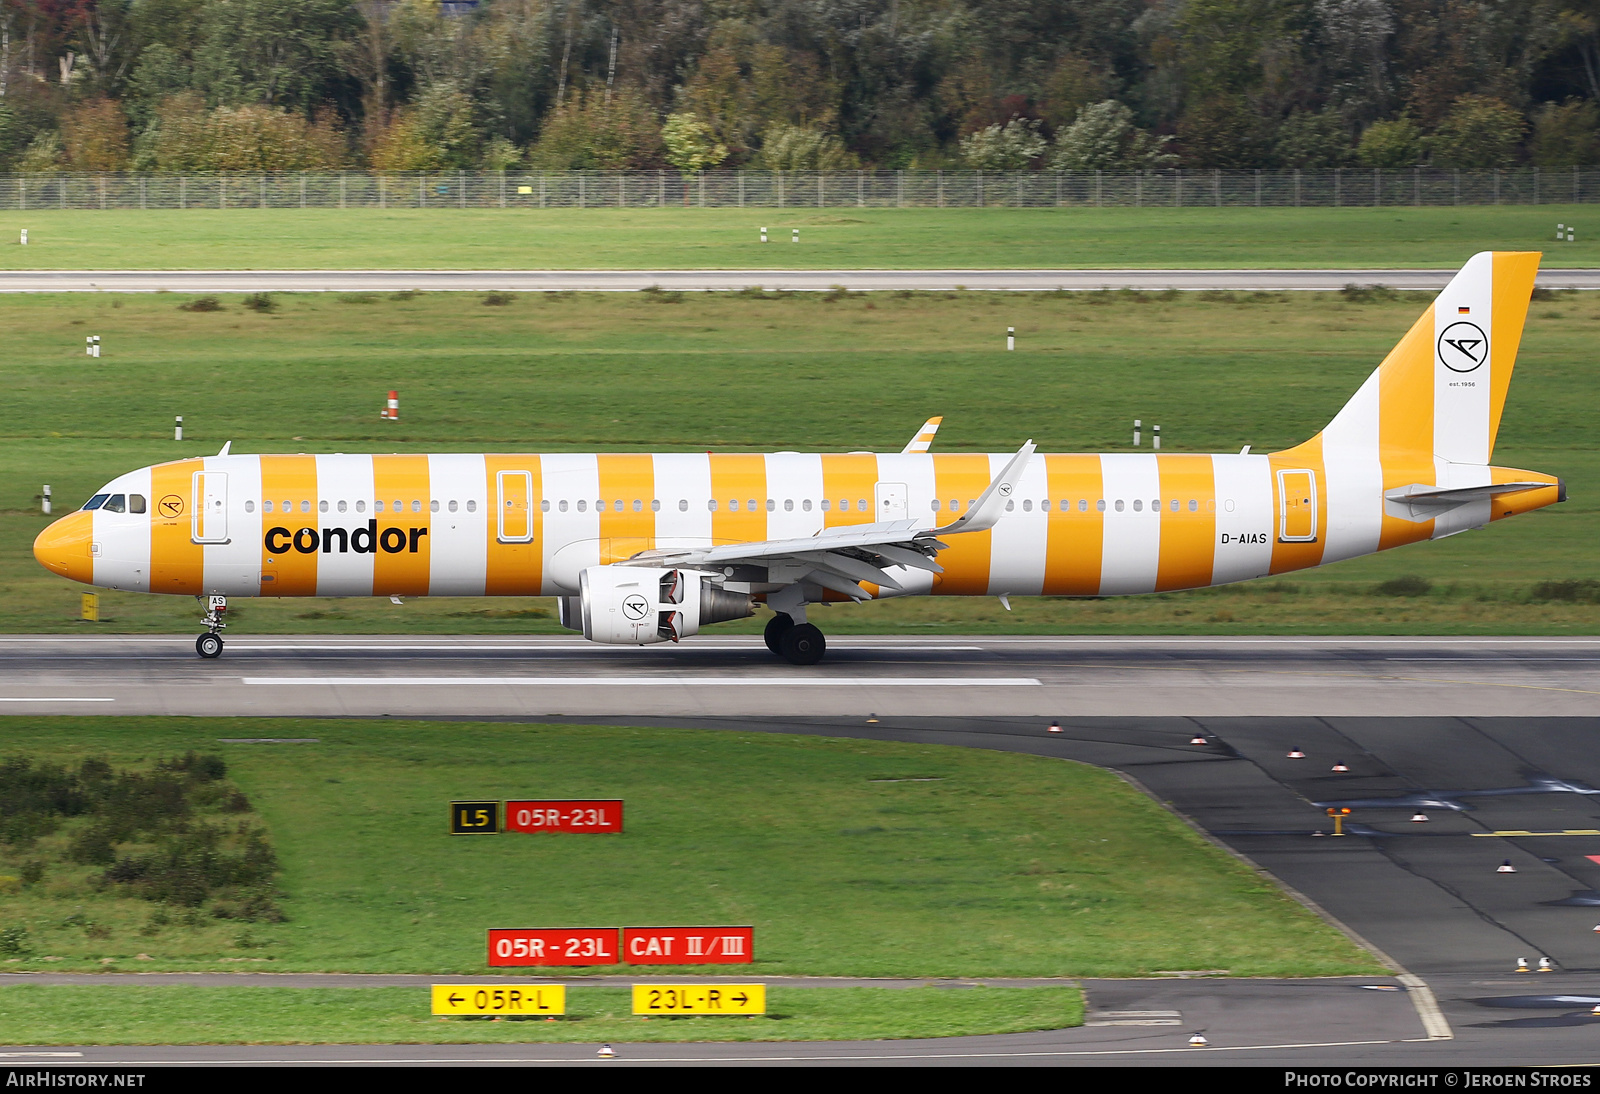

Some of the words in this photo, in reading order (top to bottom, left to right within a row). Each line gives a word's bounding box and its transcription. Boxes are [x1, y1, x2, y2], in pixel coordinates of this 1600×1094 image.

[264, 518, 428, 555] condor
[1221, 533, 1267, 544] D-AIAS
[212, 597, 224, 605] AS
[461, 809, 489, 827] L5
[517, 808, 612, 826] 05R-23L
[630, 937, 675, 956] CAT
[474, 989, 550, 1010] 05R-L
[649, 989, 721, 1009] 23L-R
